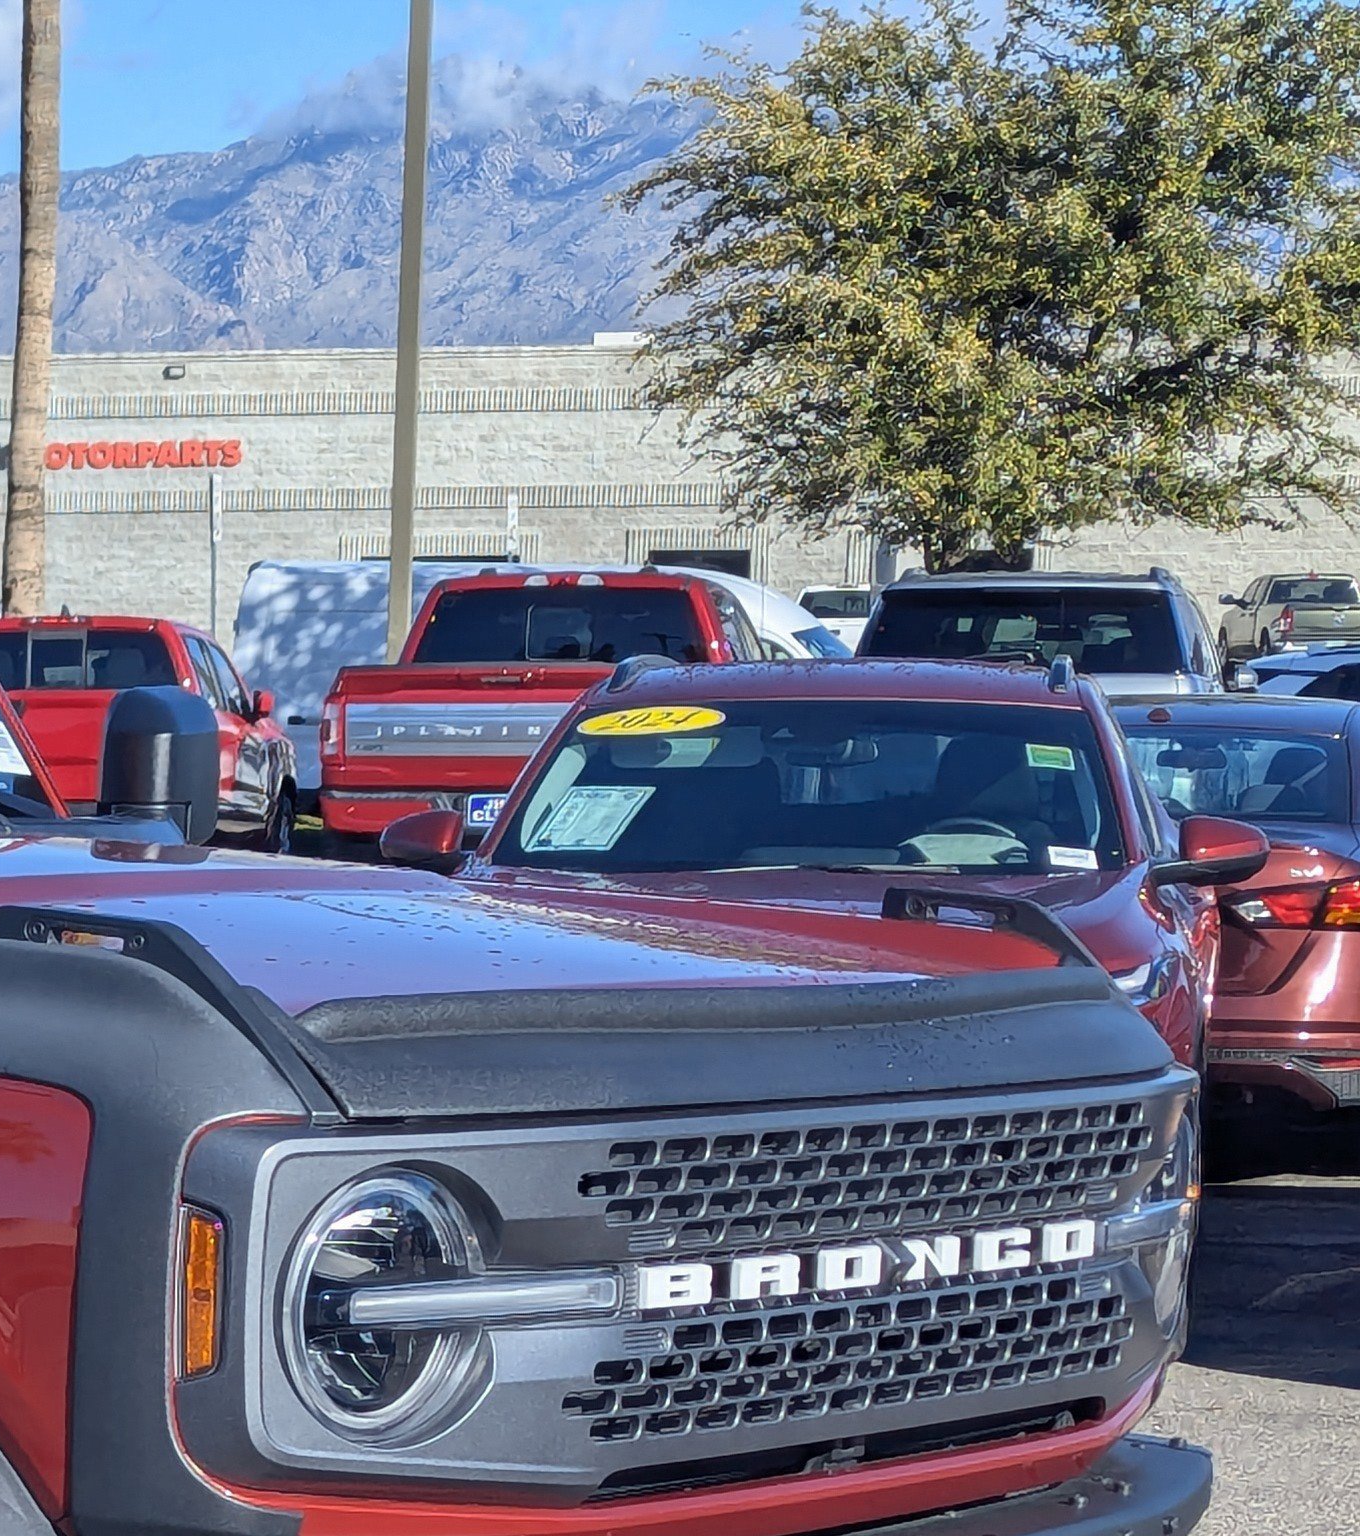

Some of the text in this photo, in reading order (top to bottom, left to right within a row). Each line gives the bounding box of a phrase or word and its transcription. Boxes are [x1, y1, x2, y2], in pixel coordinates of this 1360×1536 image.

[45, 439, 242, 470] OTORPARTS
[393, 724, 543, 737] PLATIN
[596, 710, 702, 731] 2024
[638, 1219, 1096, 1311] BRONCO
